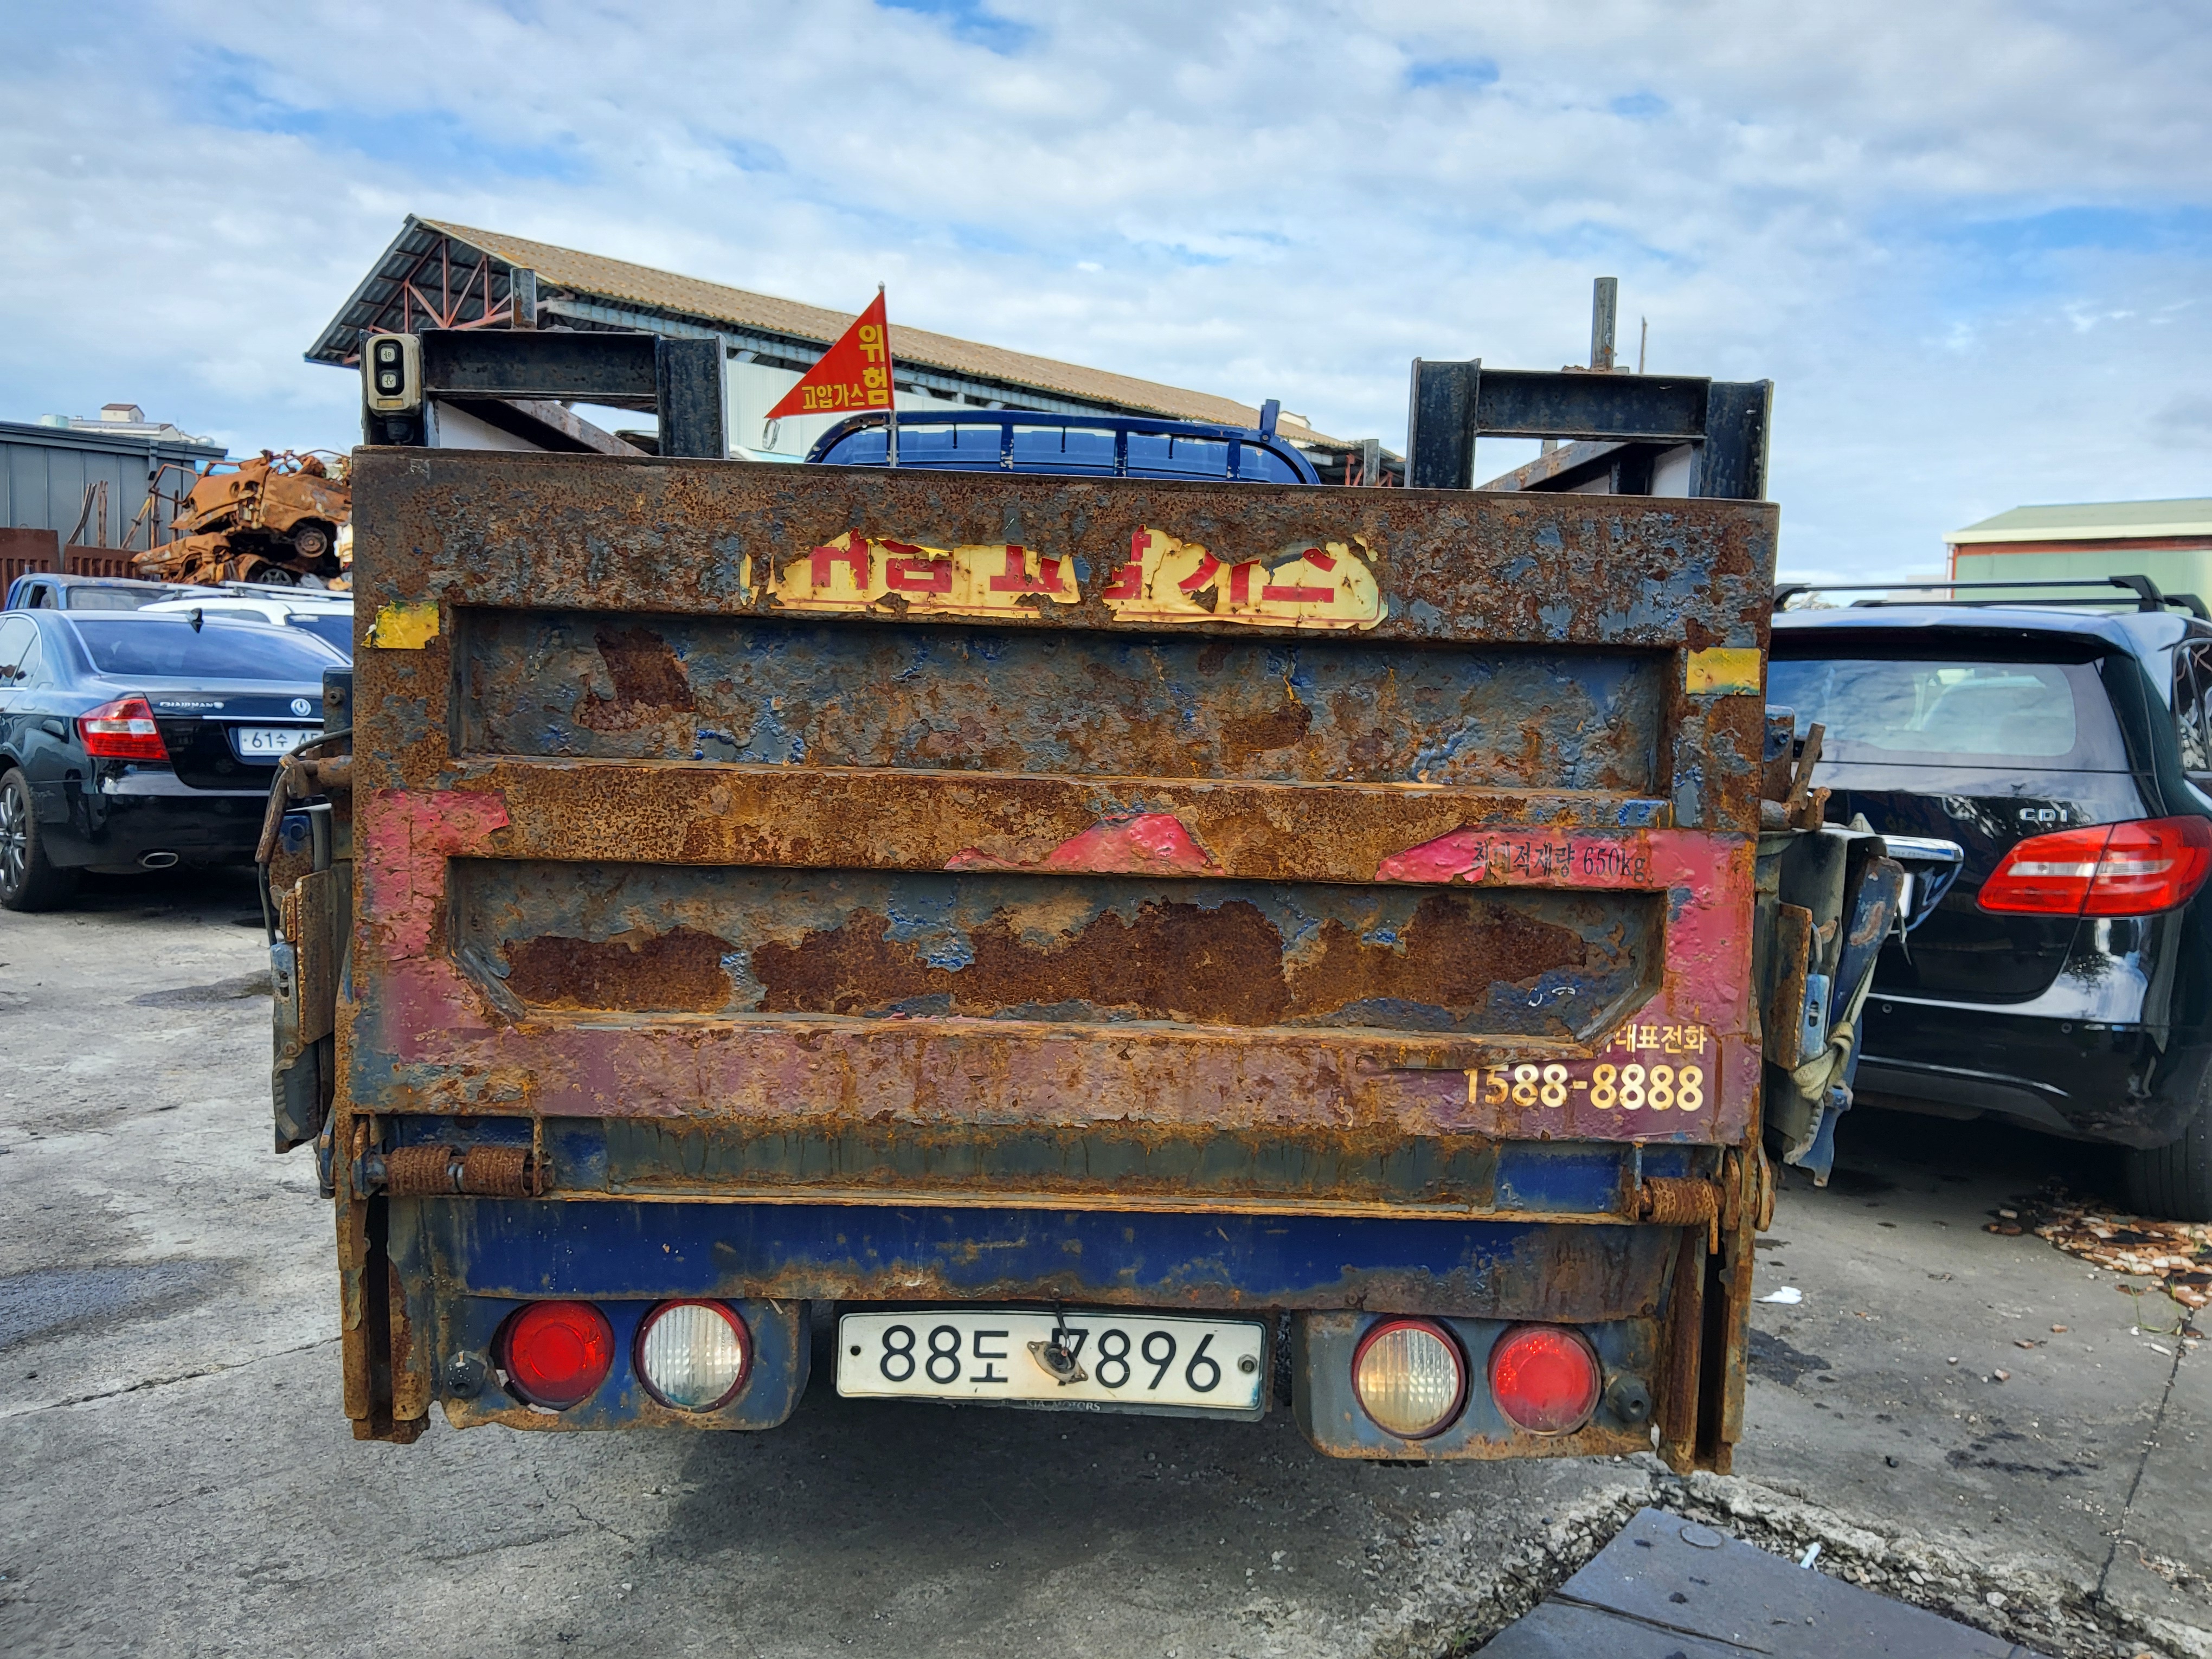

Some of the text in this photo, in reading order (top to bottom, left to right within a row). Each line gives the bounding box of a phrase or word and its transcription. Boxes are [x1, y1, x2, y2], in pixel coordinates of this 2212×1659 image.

[858, 324, 889, 405] 위험
[801, 383, 865, 410] 고압가스
[2019, 808, 2069, 823] CDI
[1471, 840, 1646, 883] 최대적재량 650kg
[1615, 1024, 1708, 1055] 대표전화
[1463, 1063, 1704, 1113] 1588-8888
